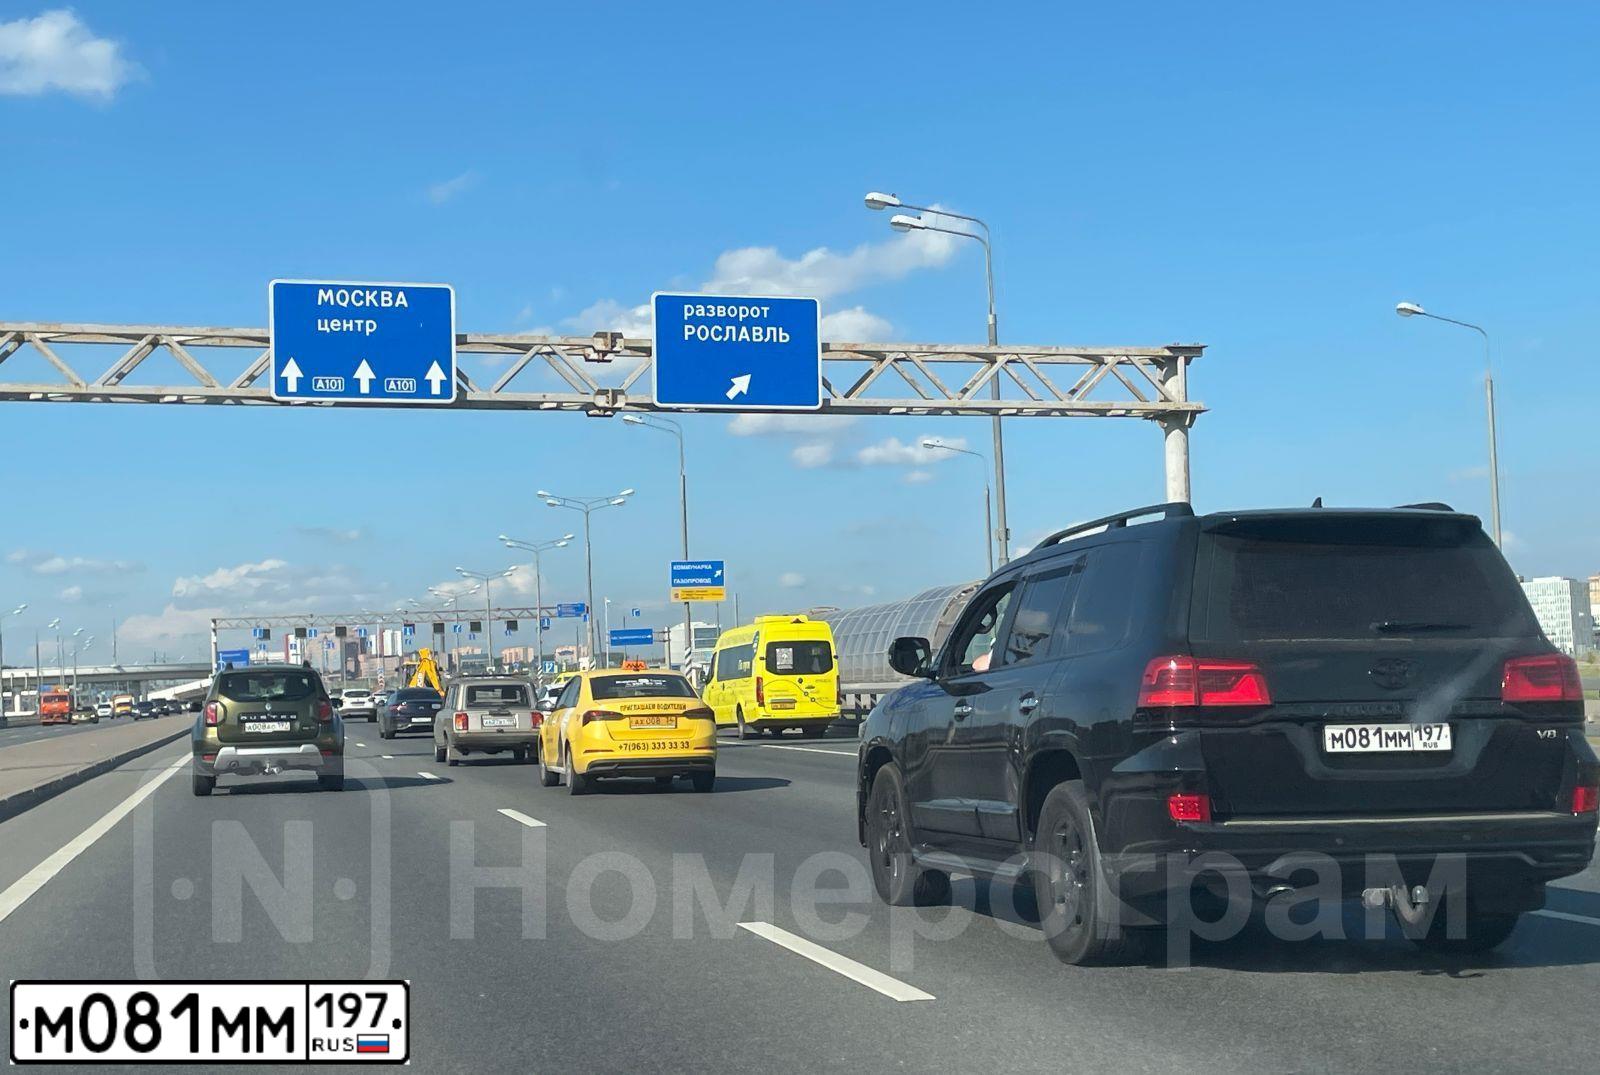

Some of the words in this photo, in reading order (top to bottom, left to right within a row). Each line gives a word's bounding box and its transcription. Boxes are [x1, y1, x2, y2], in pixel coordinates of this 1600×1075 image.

[317, 288, 409, 308] МОСКВА
[684, 303, 770, 321] разворот
[317, 318, 377, 336] центр
[684, 325, 790, 343] РОСЛАВЛЬ
[316, 379, 342, 390] А101
[388, 380, 414, 391] А101
[651, 741, 666, 750] 333
[668, 741, 678, 749] 33
[680, 740, 690, 749] 33
[1331, 727, 1412, 749] М081ММ
[1414, 725, 1444, 741] 197
